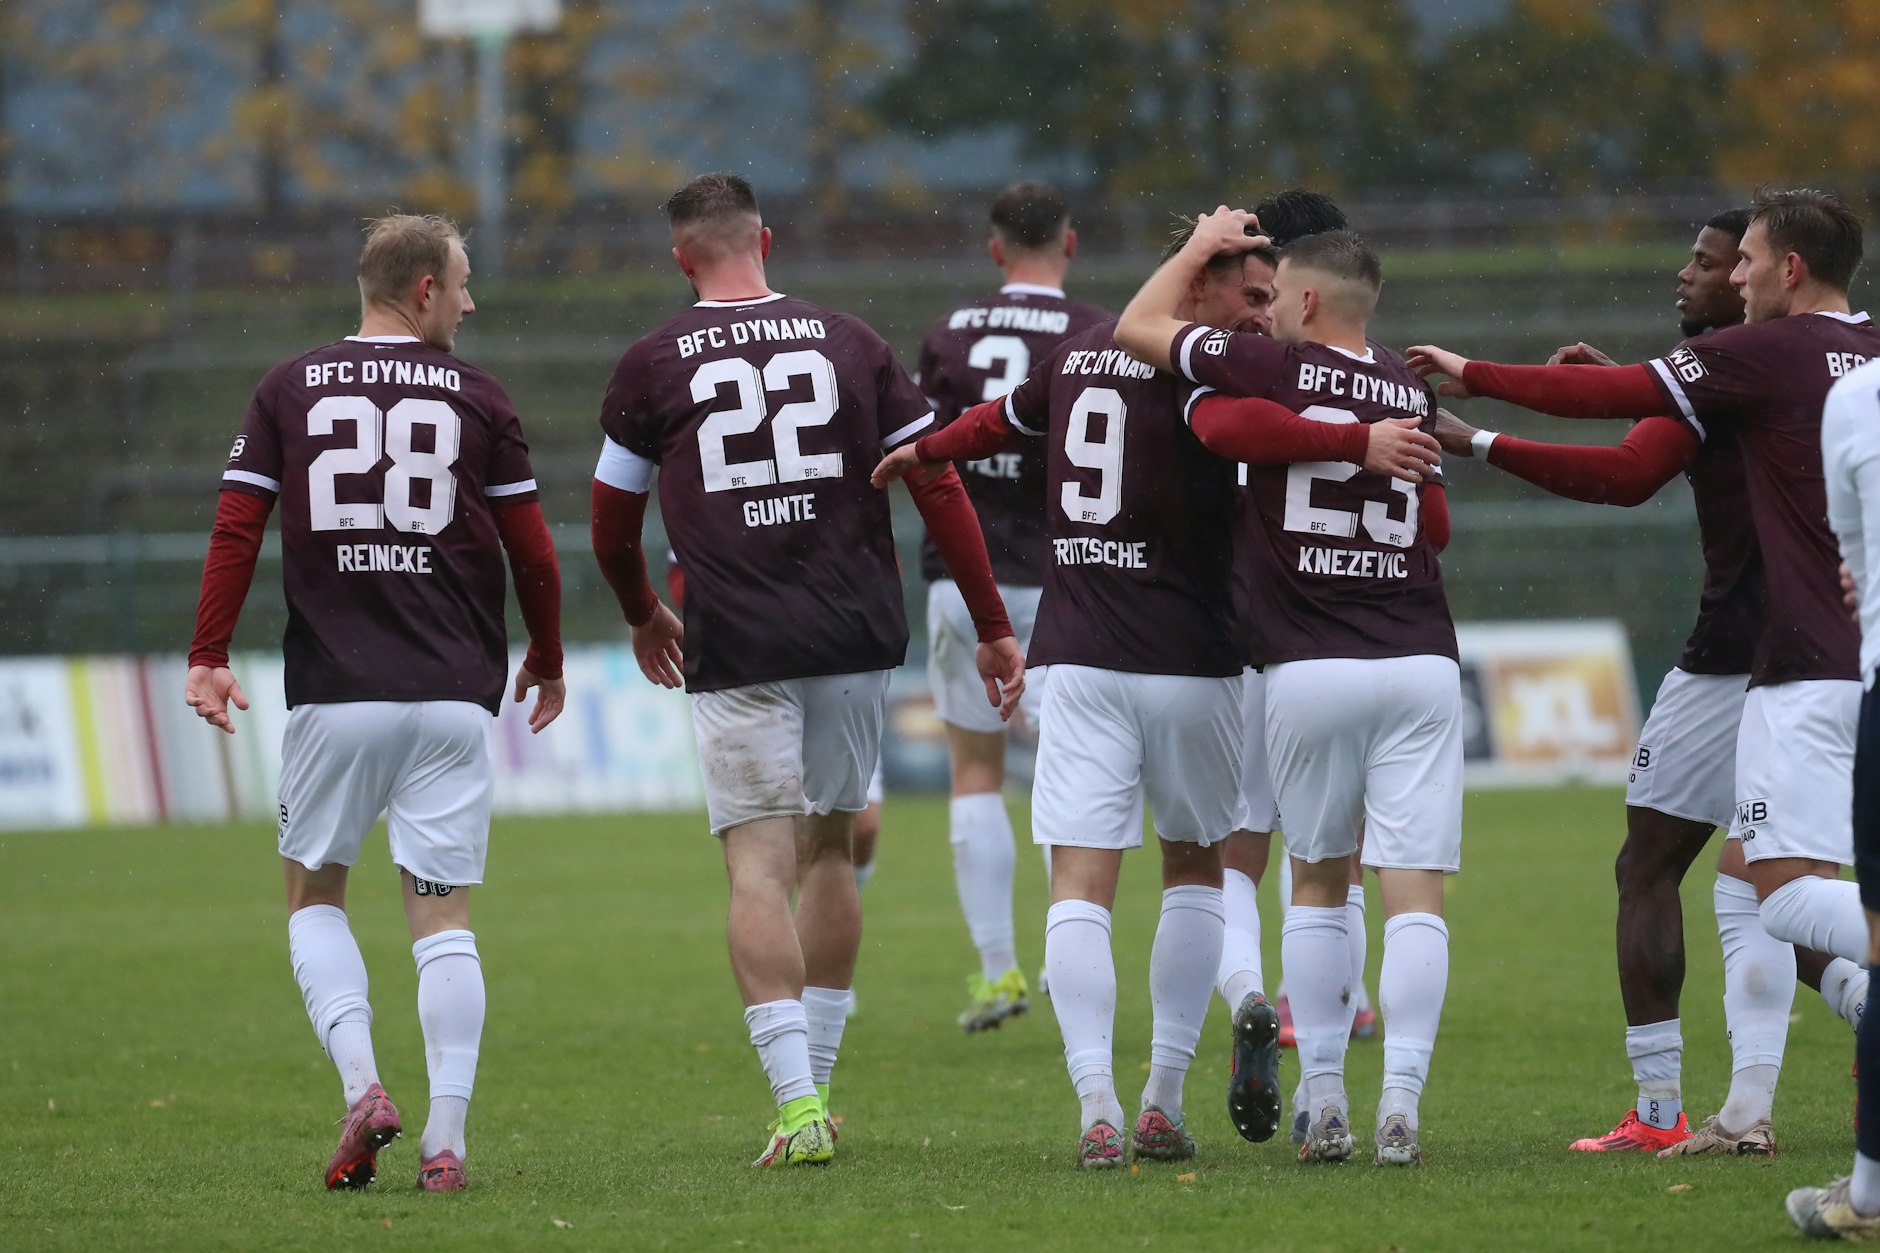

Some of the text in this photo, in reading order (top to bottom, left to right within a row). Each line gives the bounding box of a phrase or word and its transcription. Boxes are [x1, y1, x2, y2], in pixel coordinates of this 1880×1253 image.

[677, 318, 826, 359] BFC DYNAMO
[305, 360, 460, 392] BFC DYNAMO
[1062, 350, 1098, 375] BFC
[1298, 363, 1429, 417] BFC DYNAMO
[689, 349, 843, 493] 22
[307, 395, 461, 536] 28
[1061, 387, 1127, 525] 9
[731, 476, 747, 487] BFC
[804, 468, 819, 478] BFC
[339, 517, 355, 528] BFC
[743, 493, 816, 527] GUNTE
[1082, 510, 1097, 522] BFC
[411, 520, 426, 531] BFC
[1310, 521, 1327, 532] BFC
[1388, 532, 1402, 545] BFC
[337, 544, 433, 574] REINCKE
[1298, 546, 1408, 578] KNEZEVIC
[1650, 1100, 1659, 1123] CKS
